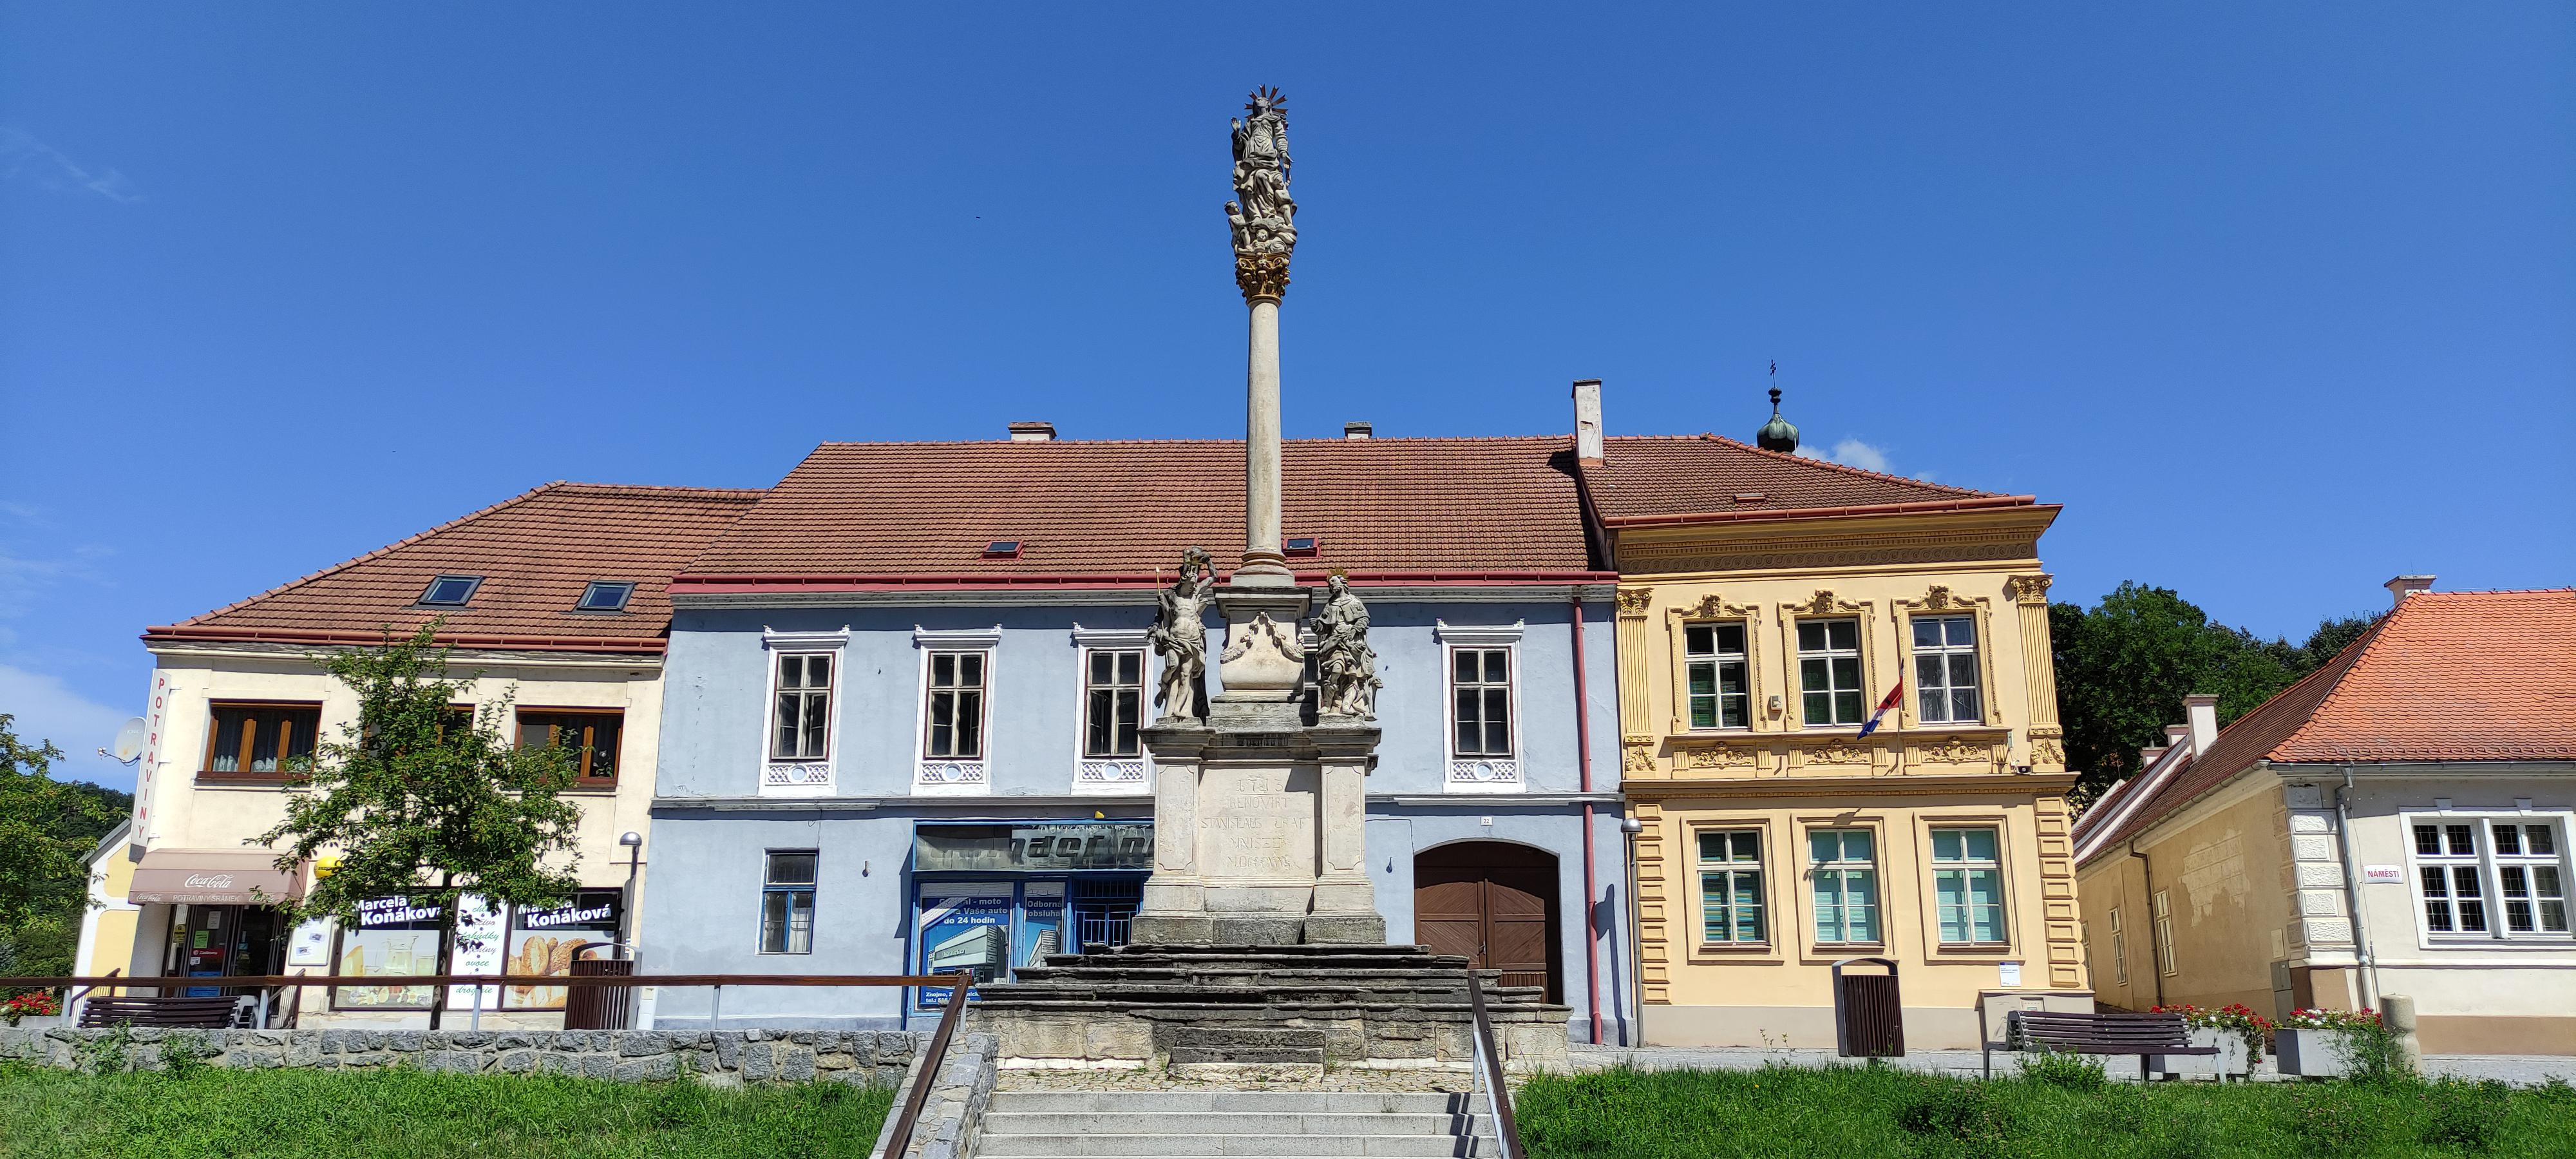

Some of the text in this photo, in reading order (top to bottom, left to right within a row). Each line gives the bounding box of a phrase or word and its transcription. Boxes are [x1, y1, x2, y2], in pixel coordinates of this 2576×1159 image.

[138, 678, 164, 838] POTRAVINY
[2367, 868, 2400, 877] NÁMĚSTÍ
[527, 903, 611, 928] Koňáková
[943, 916, 955, 924] do
[455, 986, 493, 996] drogie
